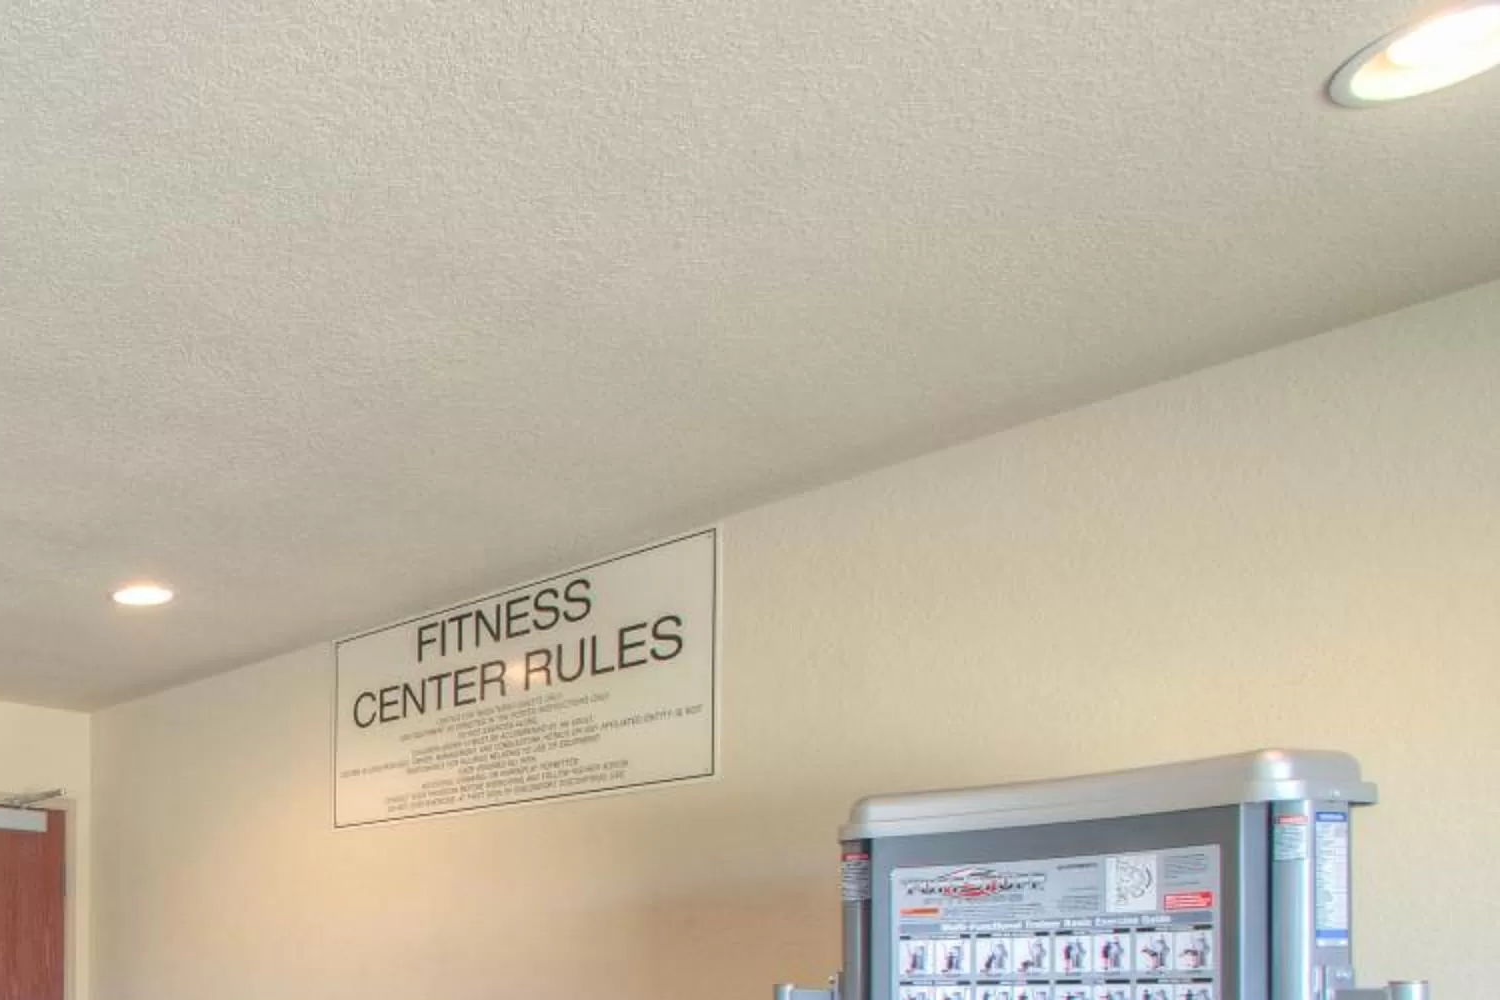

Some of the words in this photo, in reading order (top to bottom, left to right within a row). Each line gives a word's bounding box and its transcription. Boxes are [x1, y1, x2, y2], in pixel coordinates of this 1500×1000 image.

[416, 578, 592, 662] FITNESS
[353, 659, 507, 729] CENTER
[523, 615, 684, 692] RULES
